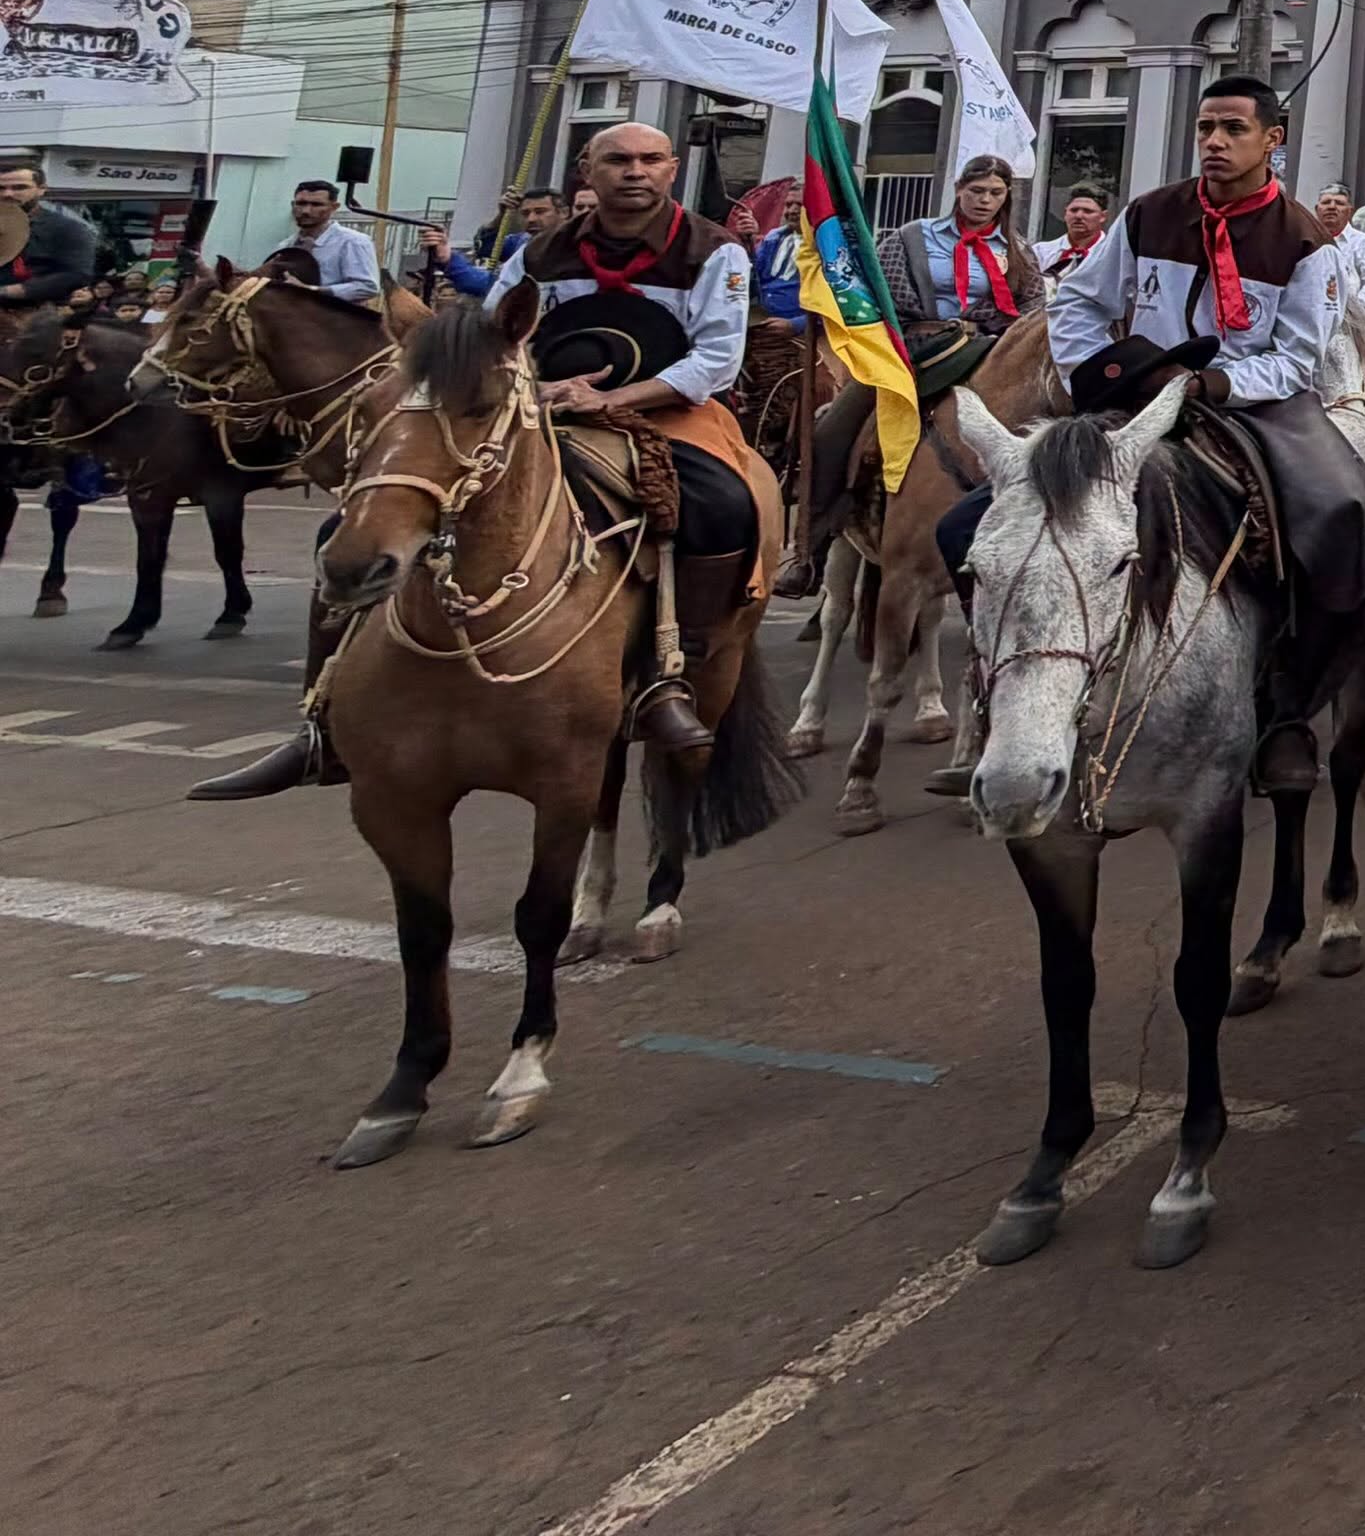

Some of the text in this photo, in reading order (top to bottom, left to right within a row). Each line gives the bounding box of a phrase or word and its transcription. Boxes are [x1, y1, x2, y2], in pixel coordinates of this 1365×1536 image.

[664, 8, 796, 56] MARCA DE CASCO
